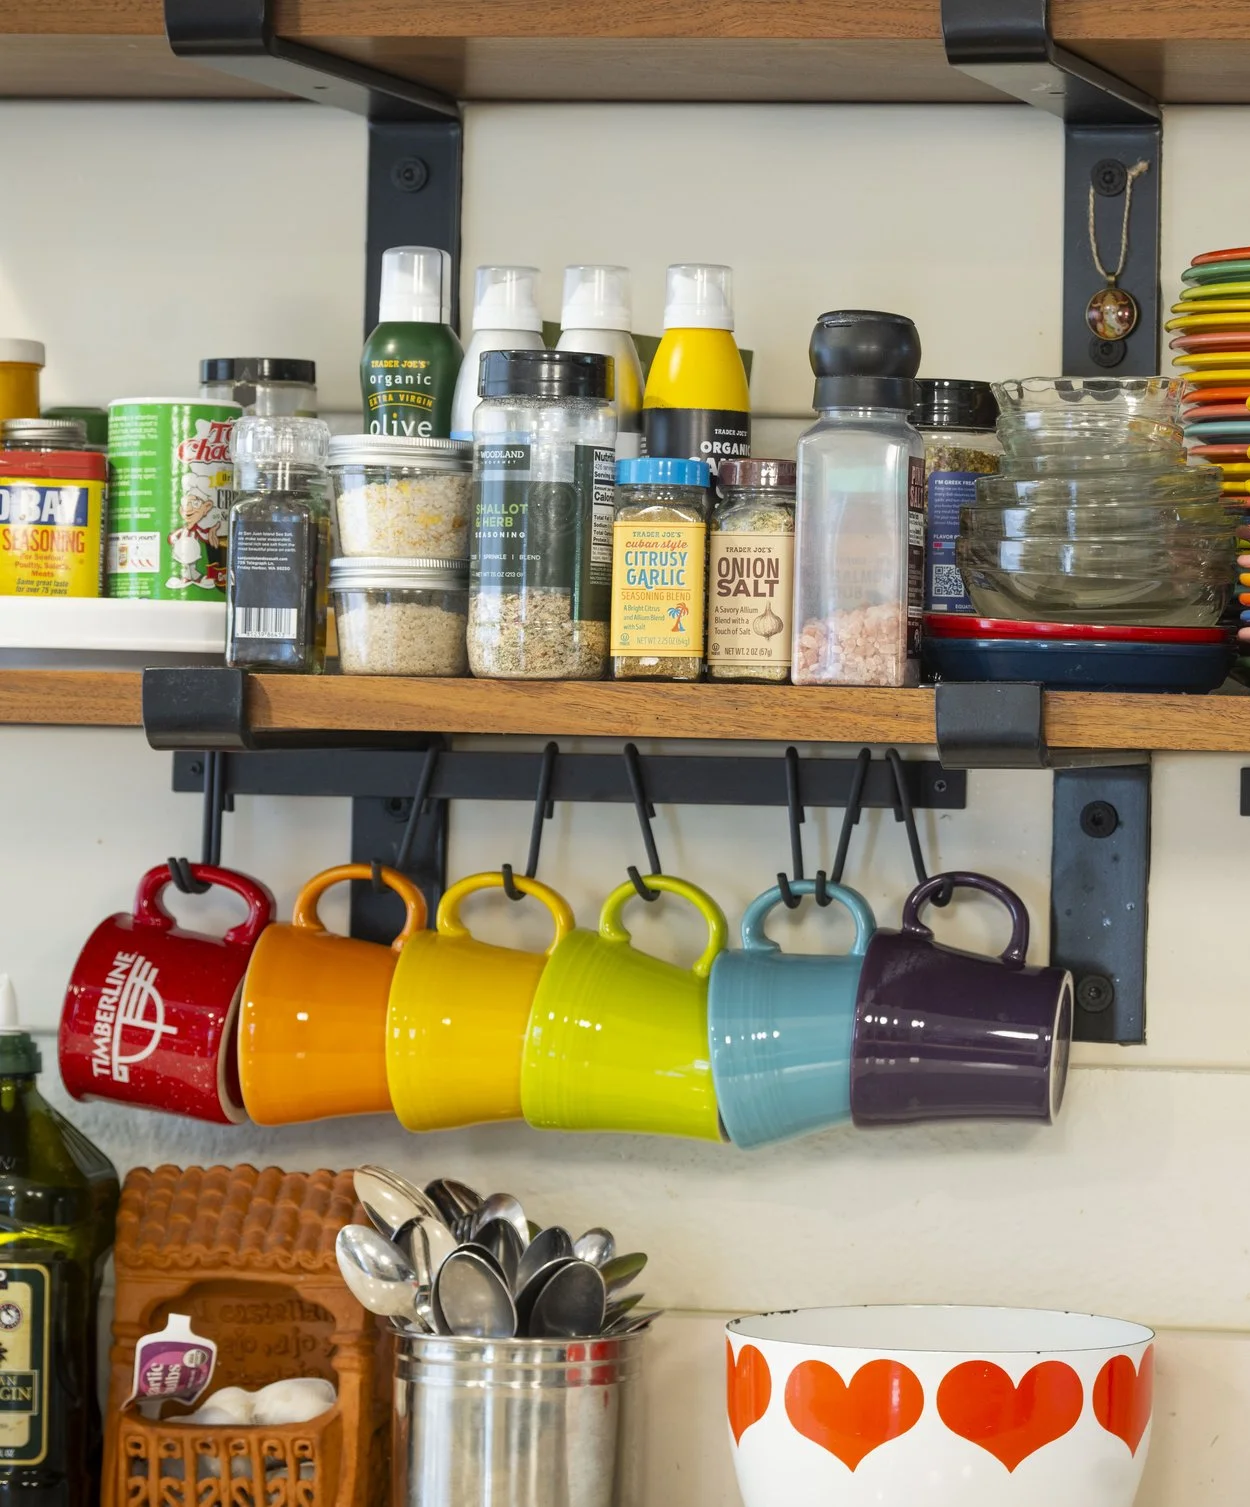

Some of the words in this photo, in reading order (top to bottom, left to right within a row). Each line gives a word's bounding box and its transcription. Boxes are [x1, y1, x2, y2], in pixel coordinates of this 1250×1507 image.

[371, 360, 399, 368] TRADER
[401, 360, 427, 368] JOE'S
[370, 373, 432, 387] organic
[369, 394, 394, 407] EXTRA
[399, 394, 433, 407] VIRGIN
[370, 412, 433, 437] olive
[481, 450, 525, 459] WOODLAND
[13, 487, 80, 524] BAY
[475, 504, 528, 515] SHALLOT
[481, 516, 514, 528] HERB
[2, 528, 85, 553] SEASONING
[475, 531, 526, 539] SEASONING
[625, 540, 660, 549] cuban
[660, 540, 688, 551] style
[625, 551, 688, 567] CITRUSY
[717, 556, 780, 584] ONION
[36, 580, 52, 588] great
[627, 569, 686, 589] GARLIC
[716, 578, 780, 597] SALT
[621, 591, 664, 601] SEASONING
[666, 593, 691, 601] BLEND
[628, 604, 644, 613] Bright
[719, 606, 740, 615] Savory
[740, 606, 759, 614] Allium
[650, 614, 665, 622] Blend
[714, 616, 731, 624] Blend
[731, 617, 745, 625] with
[635, 623, 646, 631] Salt
[714, 627, 731, 635] Touch
[739, 627, 751, 635] Salt
[724, 648, 734, 656] NET
[750, 648, 758, 656] OZ
[91, 951, 139, 1077] TIMBERLINE
[145, 1362, 164, 1397] arlic
